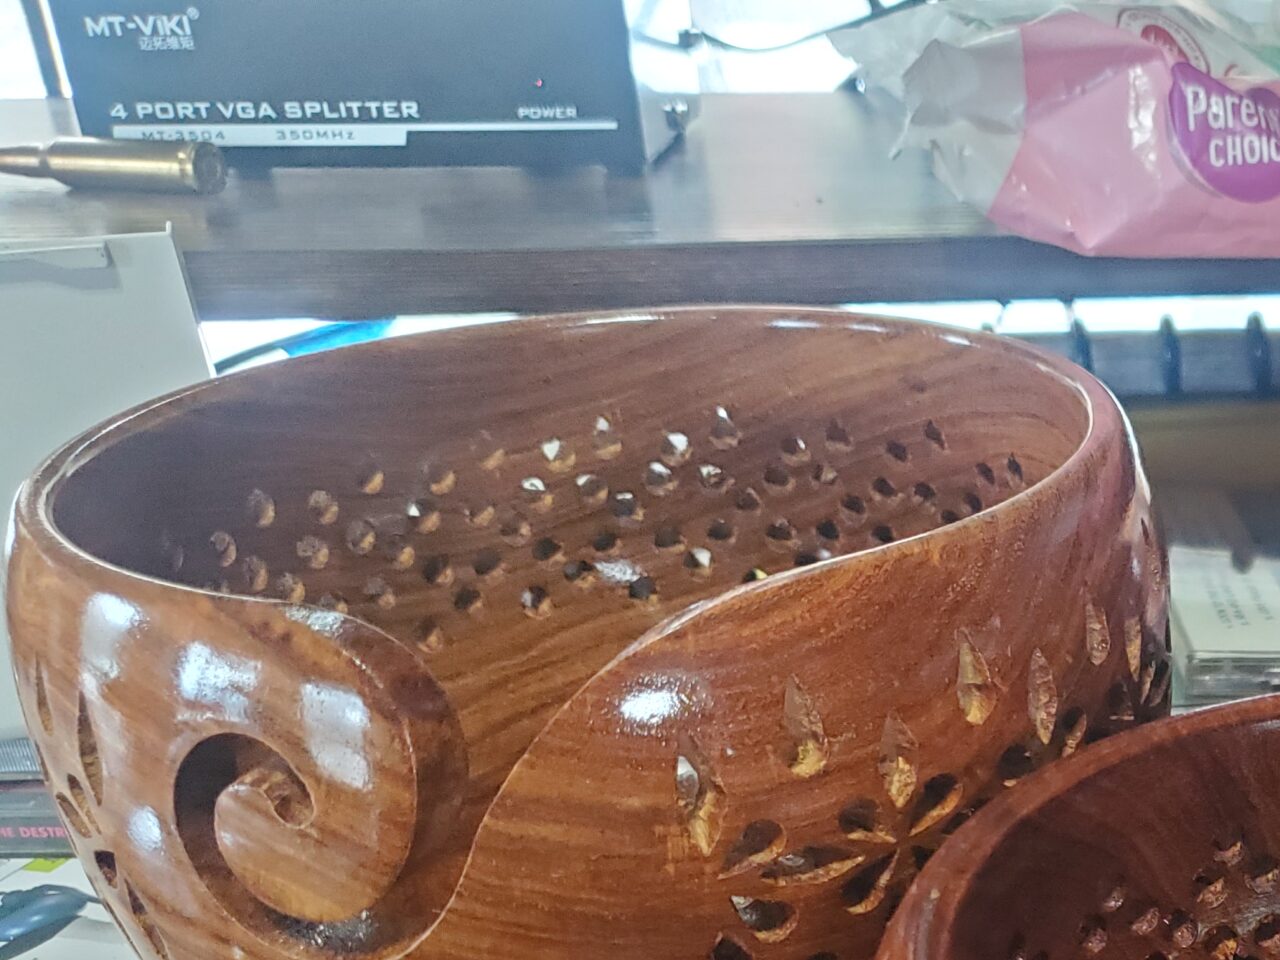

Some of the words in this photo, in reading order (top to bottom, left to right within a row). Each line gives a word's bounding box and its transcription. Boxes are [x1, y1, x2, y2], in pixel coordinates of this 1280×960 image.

[110, 103, 128, 119] 4
[136, 103, 211, 119] PORT
[217, 103, 277, 119] VGA
[285, 102, 420, 118] SPLITTER
[517, 106, 578, 119] POWER
[276, 130, 356, 141] 350MHz
